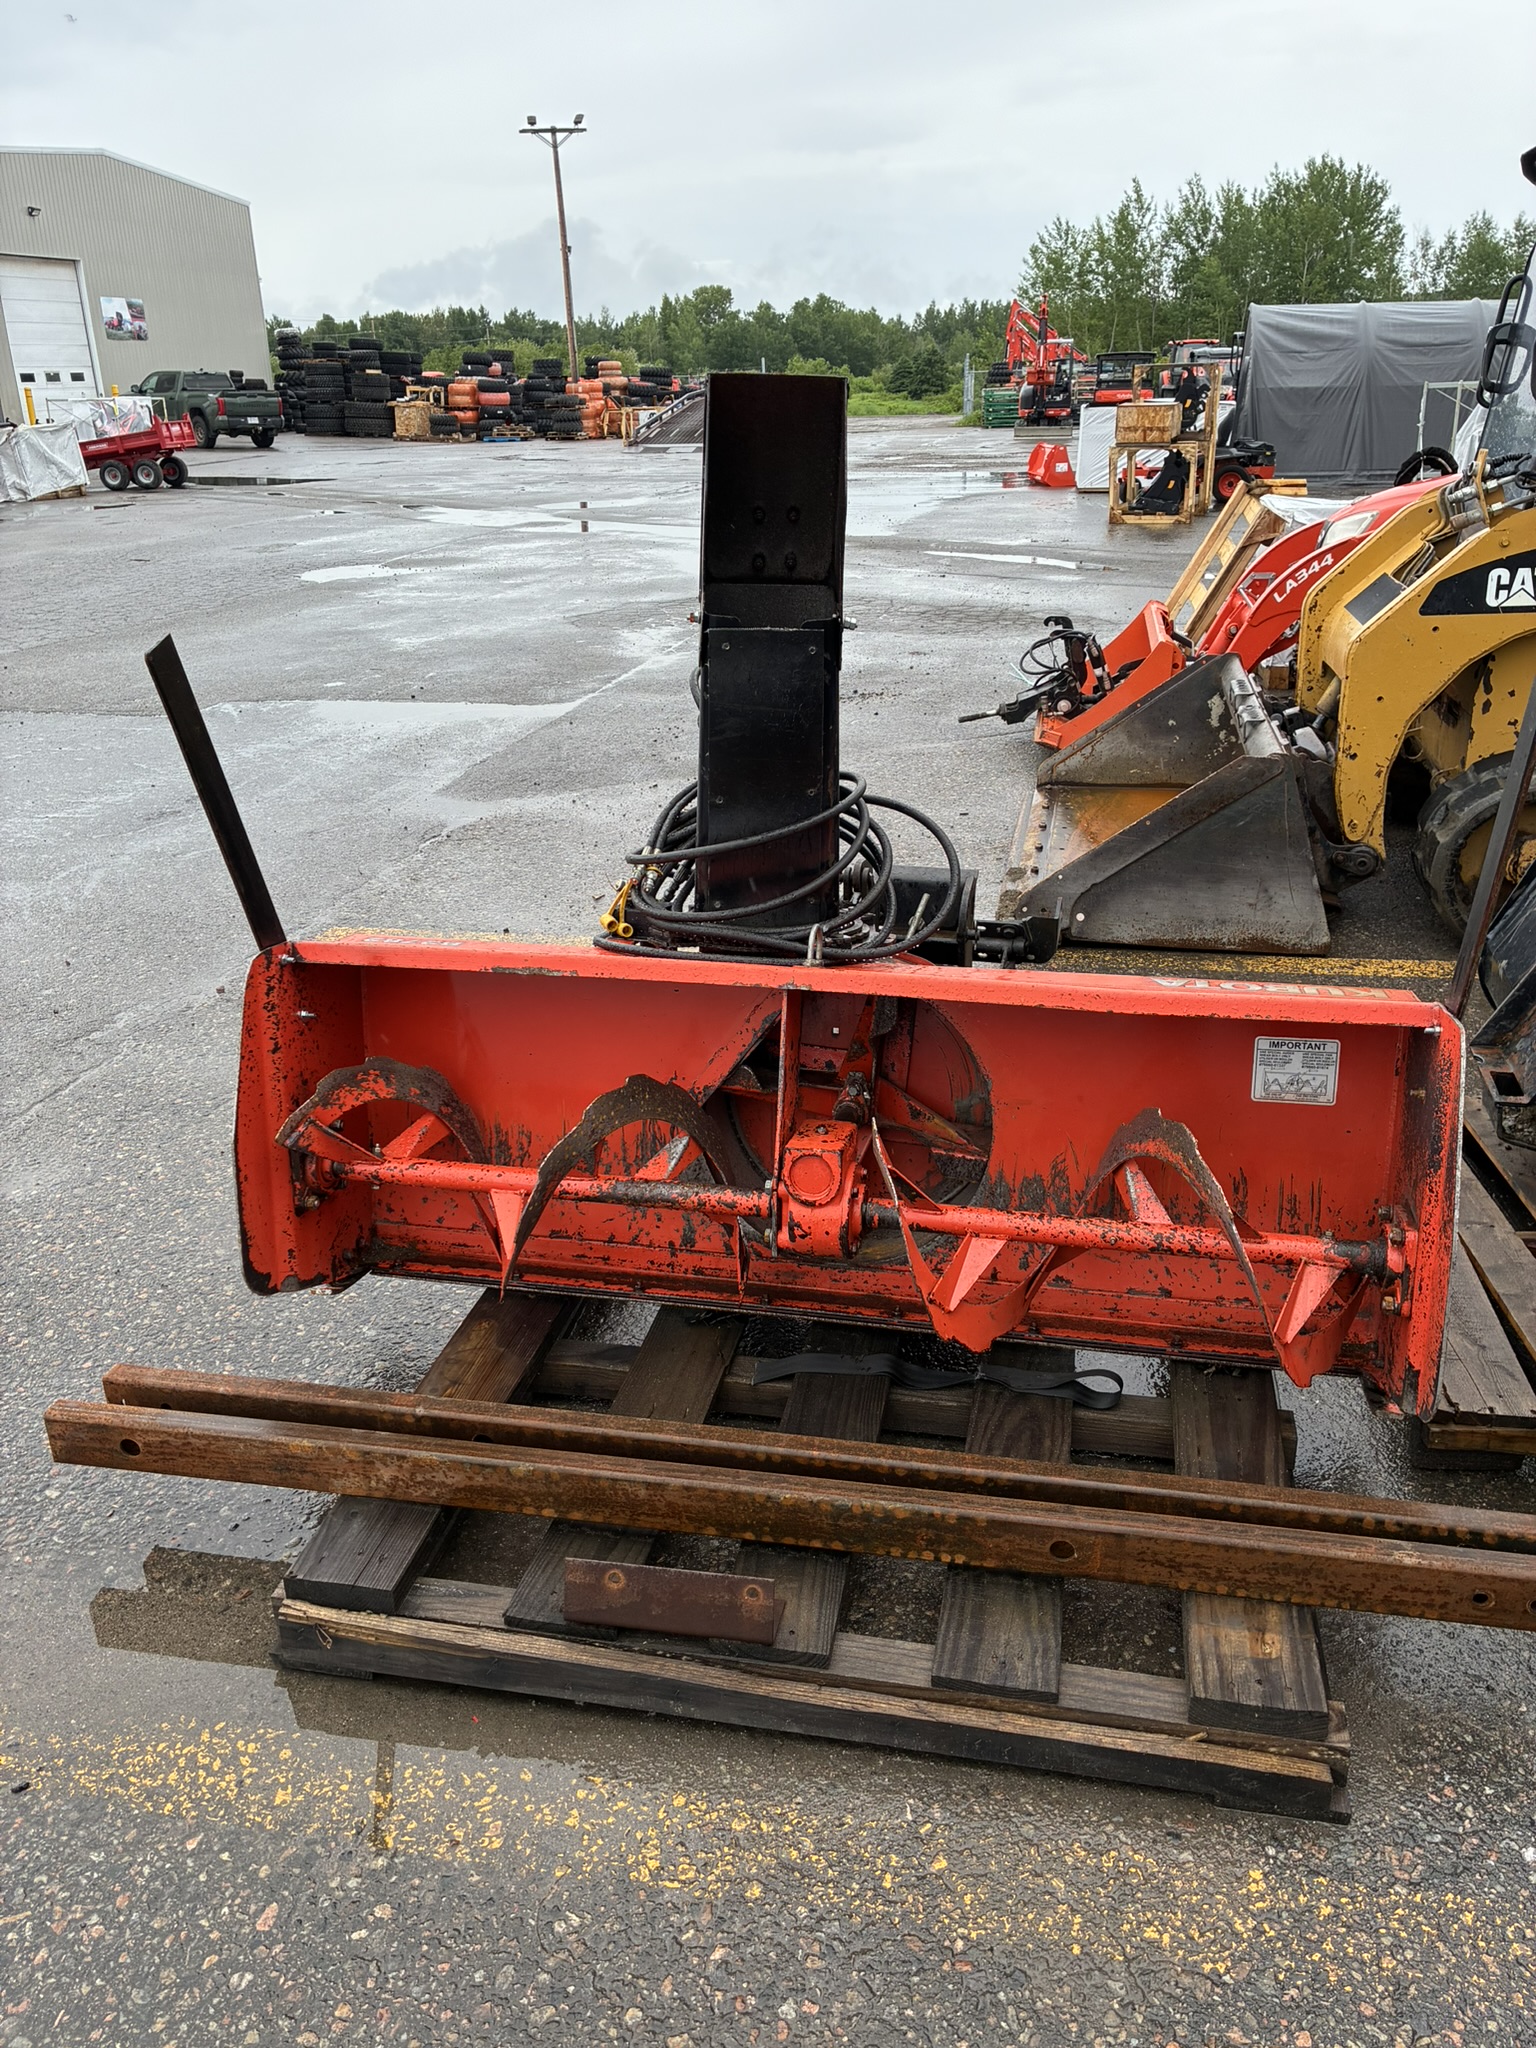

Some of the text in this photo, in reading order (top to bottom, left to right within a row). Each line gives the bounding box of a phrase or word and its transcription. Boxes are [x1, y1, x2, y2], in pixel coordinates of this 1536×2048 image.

[1273, 553, 1334, 603] LA344
[1486, 567, 1536, 607] CA
[1152, 979, 1389, 998] KUBOTA
[1268, 1040, 1328, 1051] IMPORTANT
